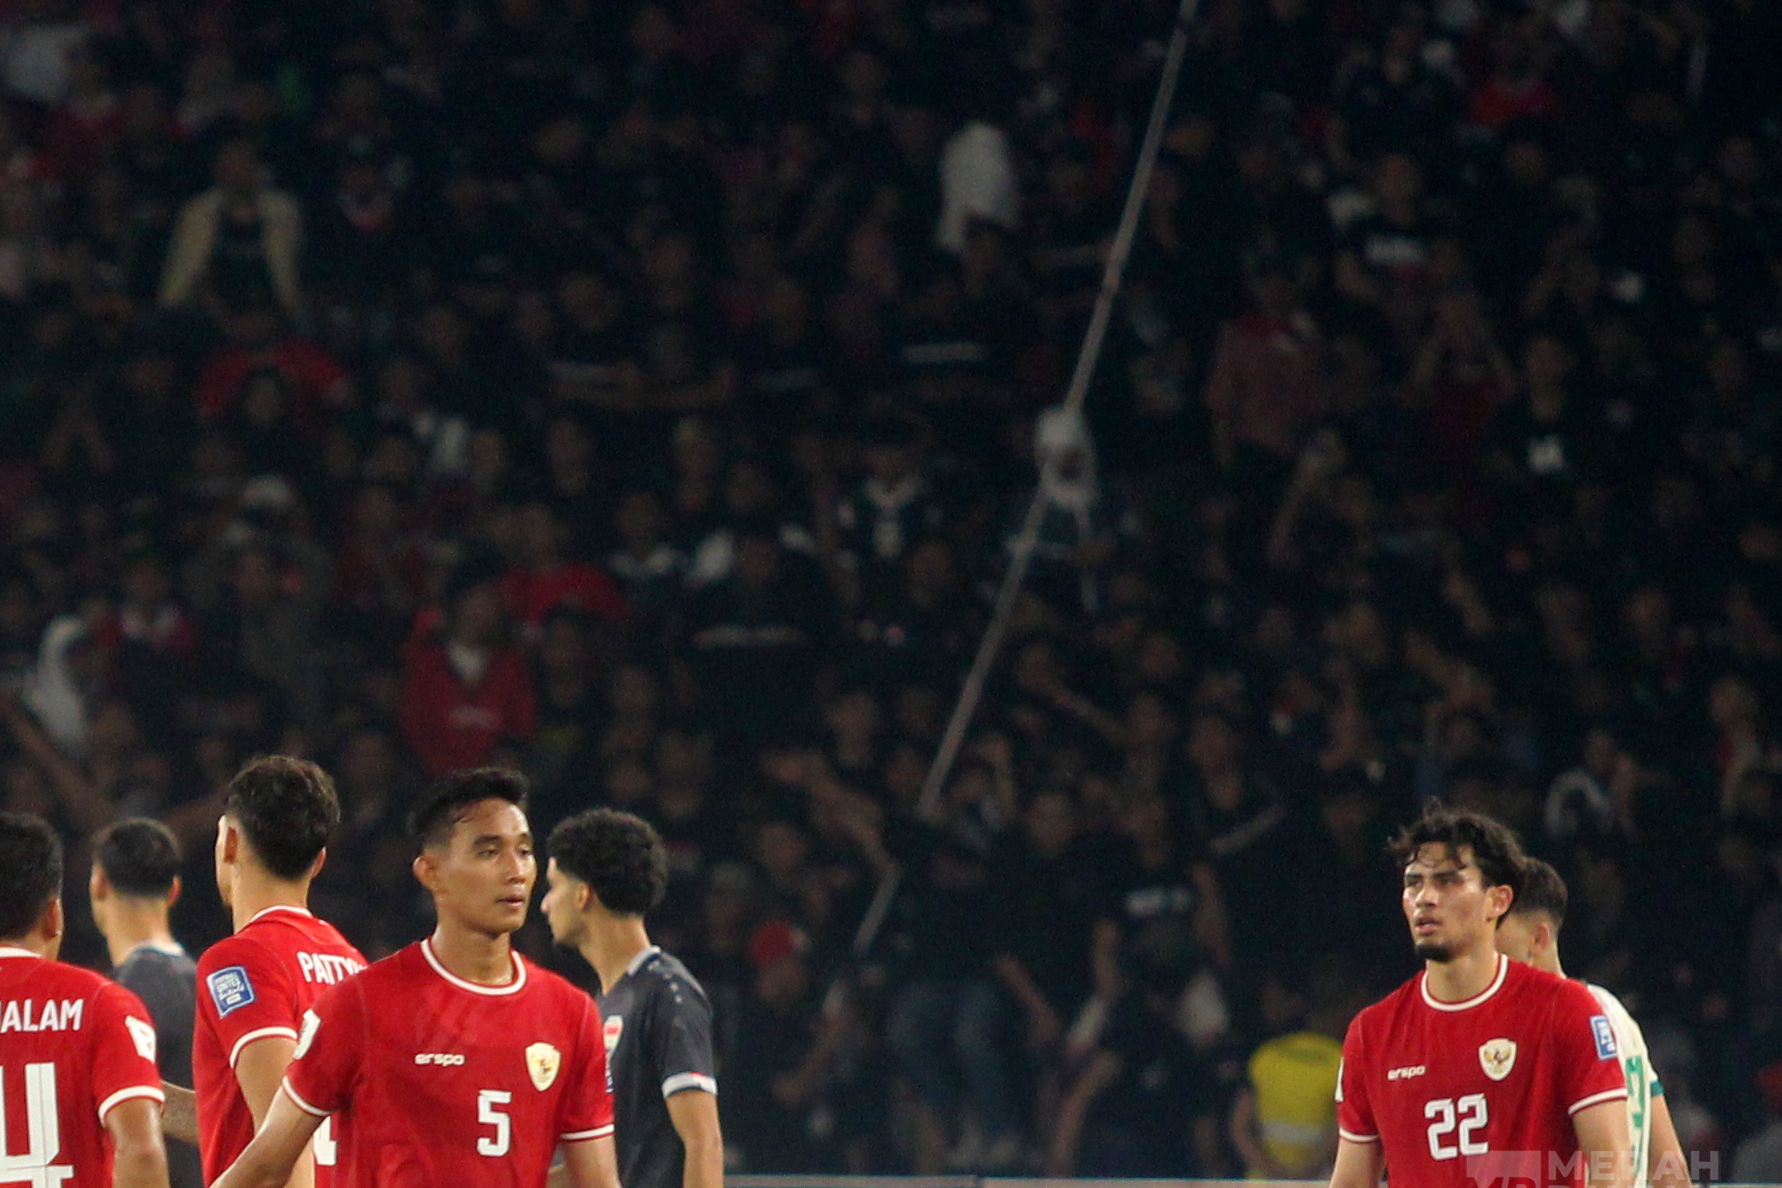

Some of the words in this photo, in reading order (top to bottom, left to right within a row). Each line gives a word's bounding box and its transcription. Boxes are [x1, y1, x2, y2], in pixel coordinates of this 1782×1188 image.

[415, 1053, 465, 1067] erspo
[1387, 1066, 1426, 1081] erspo
[477, 1089, 512, 1157] 5
[1424, 1093, 1489, 1160] 22
